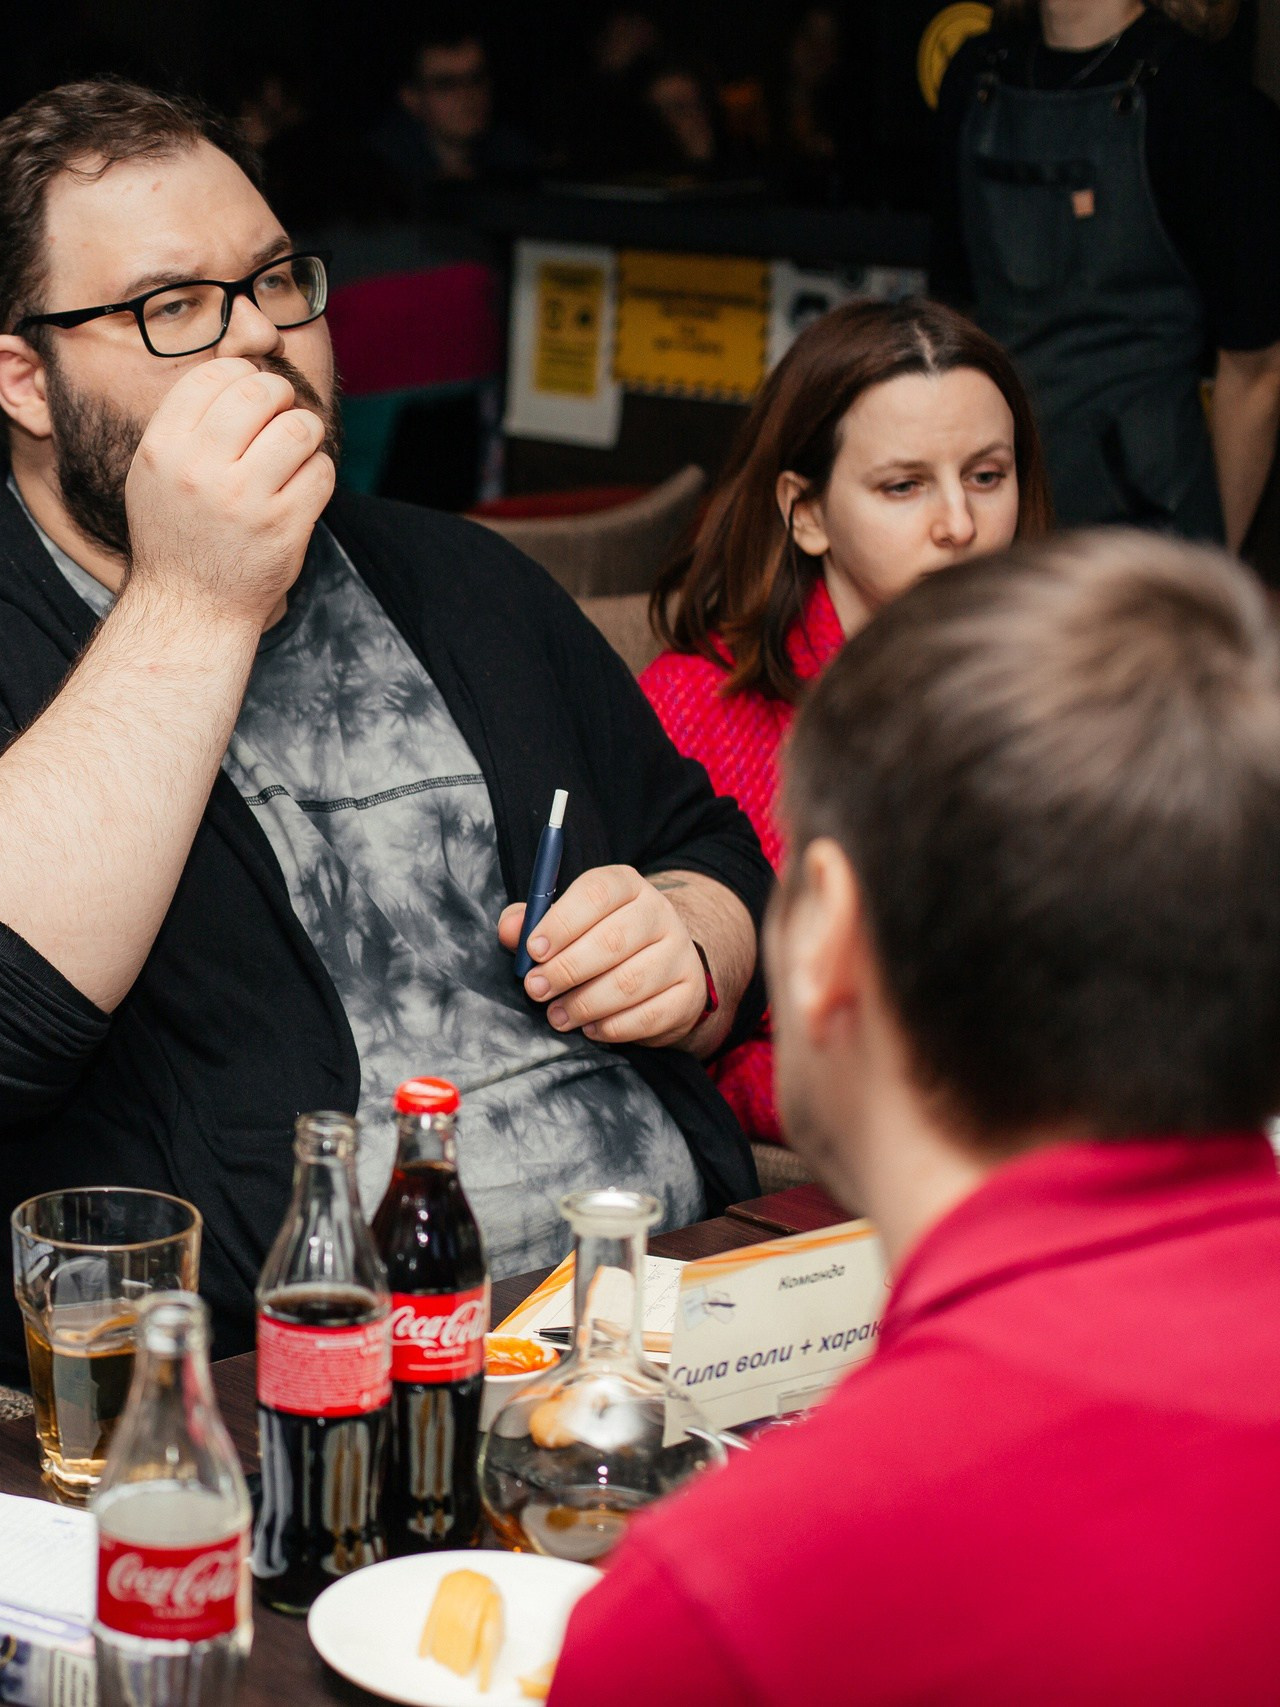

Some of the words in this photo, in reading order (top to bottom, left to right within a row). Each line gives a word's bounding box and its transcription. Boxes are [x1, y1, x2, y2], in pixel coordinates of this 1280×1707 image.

[778, 1264, 846, 1291] Команда
[735, 1343, 793, 1373] воли
[800, 1338, 814, 1356] +
